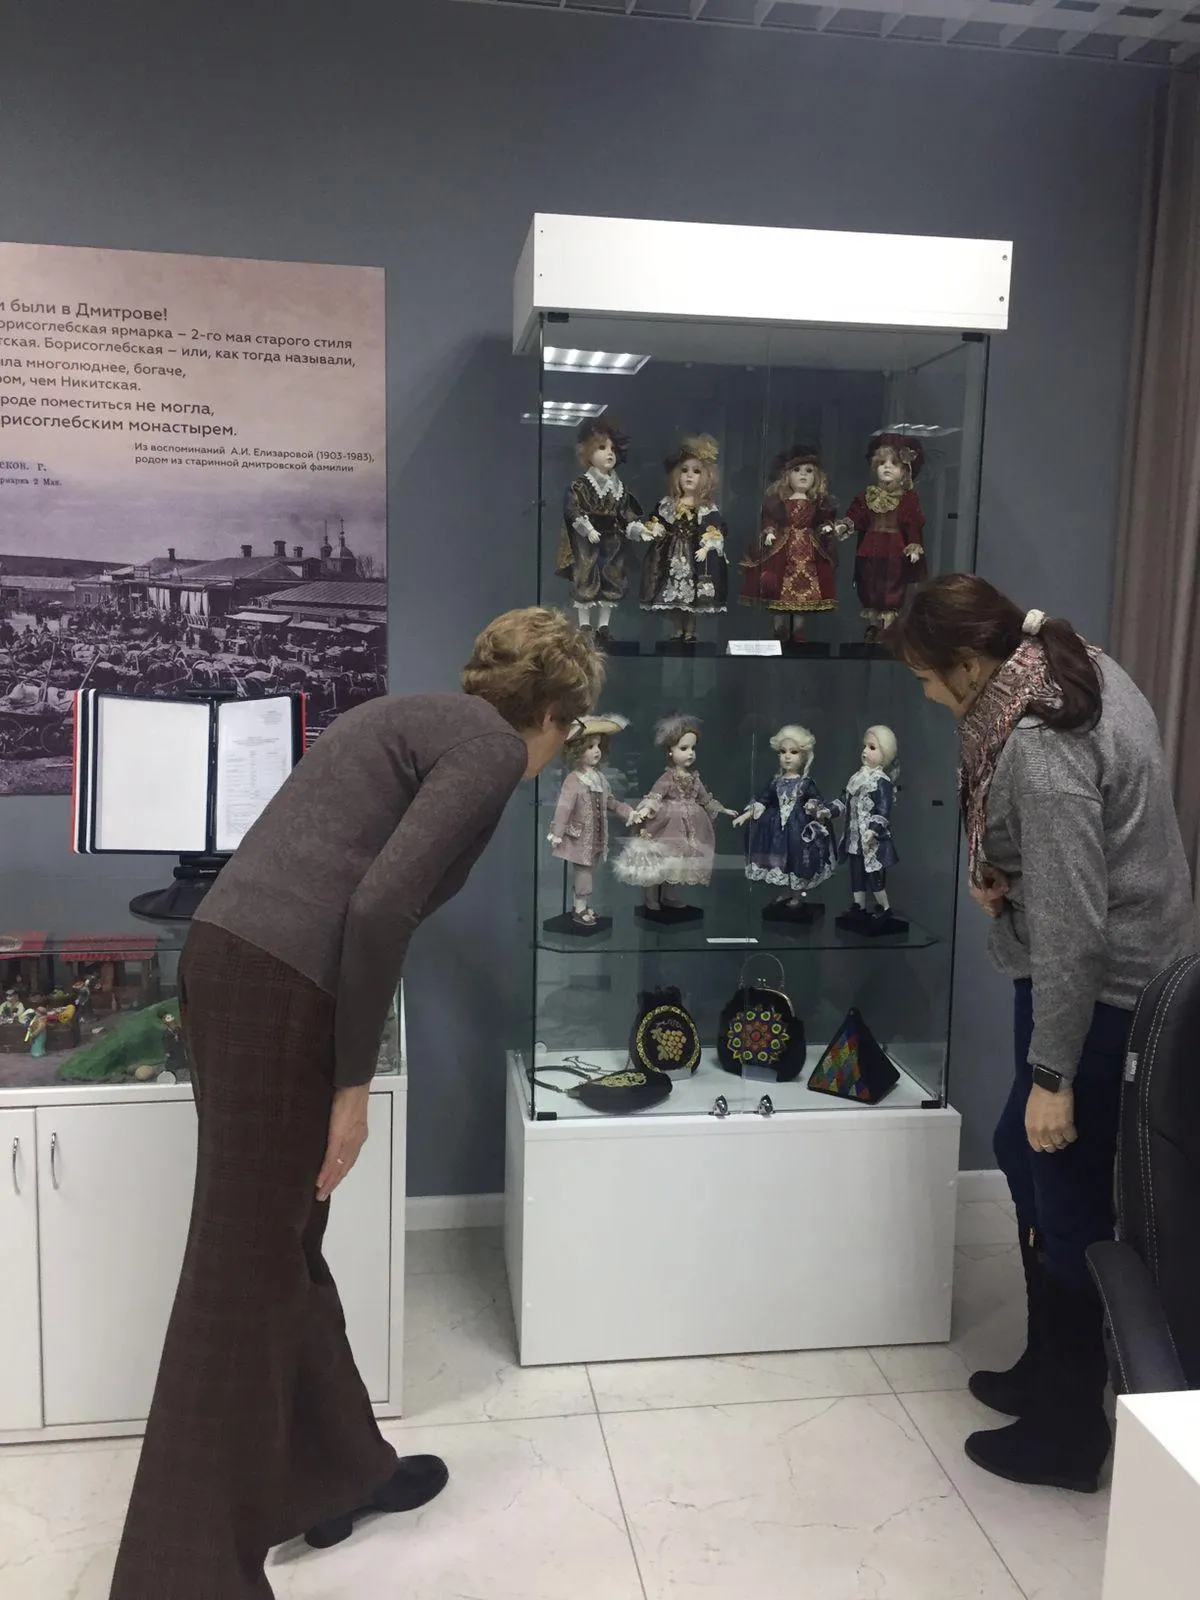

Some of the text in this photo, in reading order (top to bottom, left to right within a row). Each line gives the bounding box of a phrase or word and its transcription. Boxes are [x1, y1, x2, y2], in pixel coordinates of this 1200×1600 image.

[11, 299, 56, 314] были
[62, 305, 71, 315] в
[76, 303, 168, 321] Дмитрове!
[111, 327, 173, 340] ярмарка
[191, 328, 222, 341] 2-го
[225, 333, 251, 343] мая
[255, 334, 310, 348] старого
[313, 338, 352, 349] стиля
[45, 337, 163, 355] Борисоглебская
[181, 348, 211, 359] или,
[215, 349, 239, 360] как
[243, 352, 281, 363] тогда
[285, 355, 355, 368] называли,
[26, 359, 130, 375] многолюднее,
[134, 363, 186, 378] богаче,
[30, 376, 56, 387] чем
[61, 376, 141, 391] Никитская.
[1, 395, 215, 416] роде поместиться не могла,
[1, 415, 237, 437] рисоглебским монастырем.
[135, 442, 375, 463] Из воспоминаний А.И. Елизаровой (1903-1983),
[135, 456, 169, 465] родом
[185, 458, 239, 468] старинной
[242, 460, 307, 471] дмитровской
[310, 463, 354, 472] фамилии
